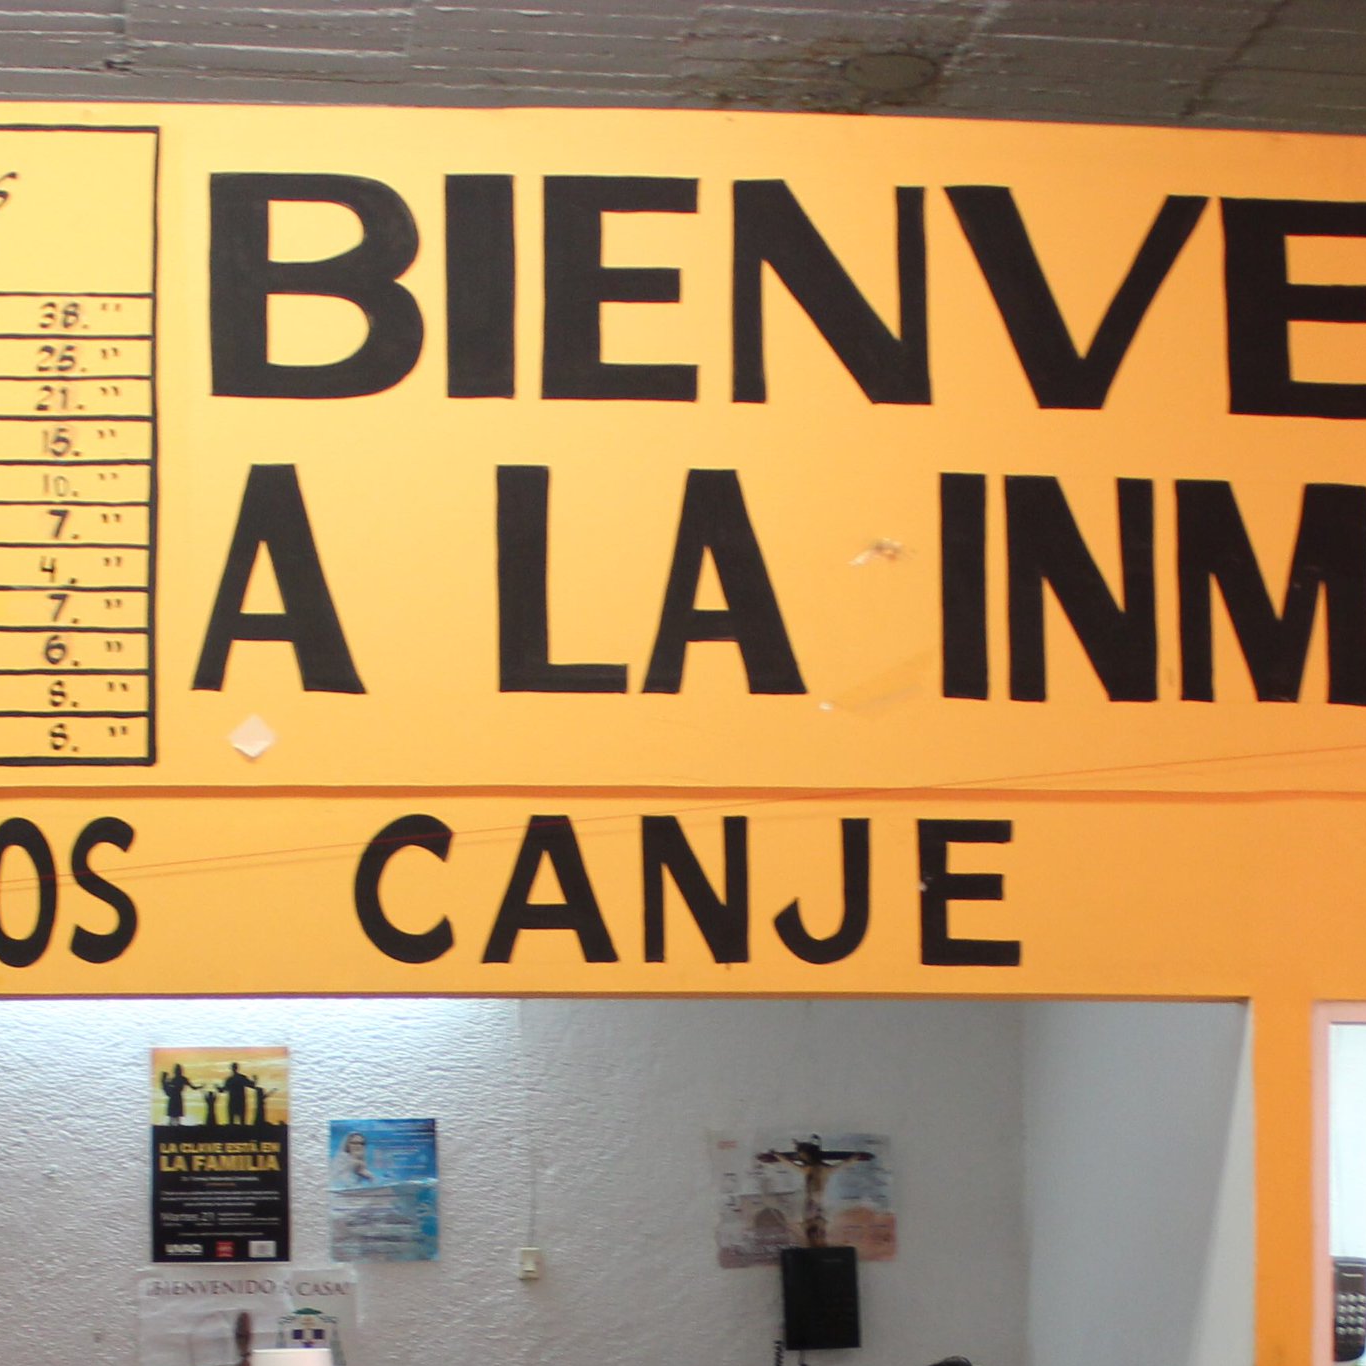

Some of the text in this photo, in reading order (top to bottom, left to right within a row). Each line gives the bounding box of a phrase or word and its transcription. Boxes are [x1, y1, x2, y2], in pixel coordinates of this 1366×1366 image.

[191, 463, 367, 694] A
[495, 464, 810, 695] LA
[353, 813, 1022, 968] CANJE
[159, 1142, 178, 1154] LA
[159, 1154, 281, 1172] LA FAMILIA
